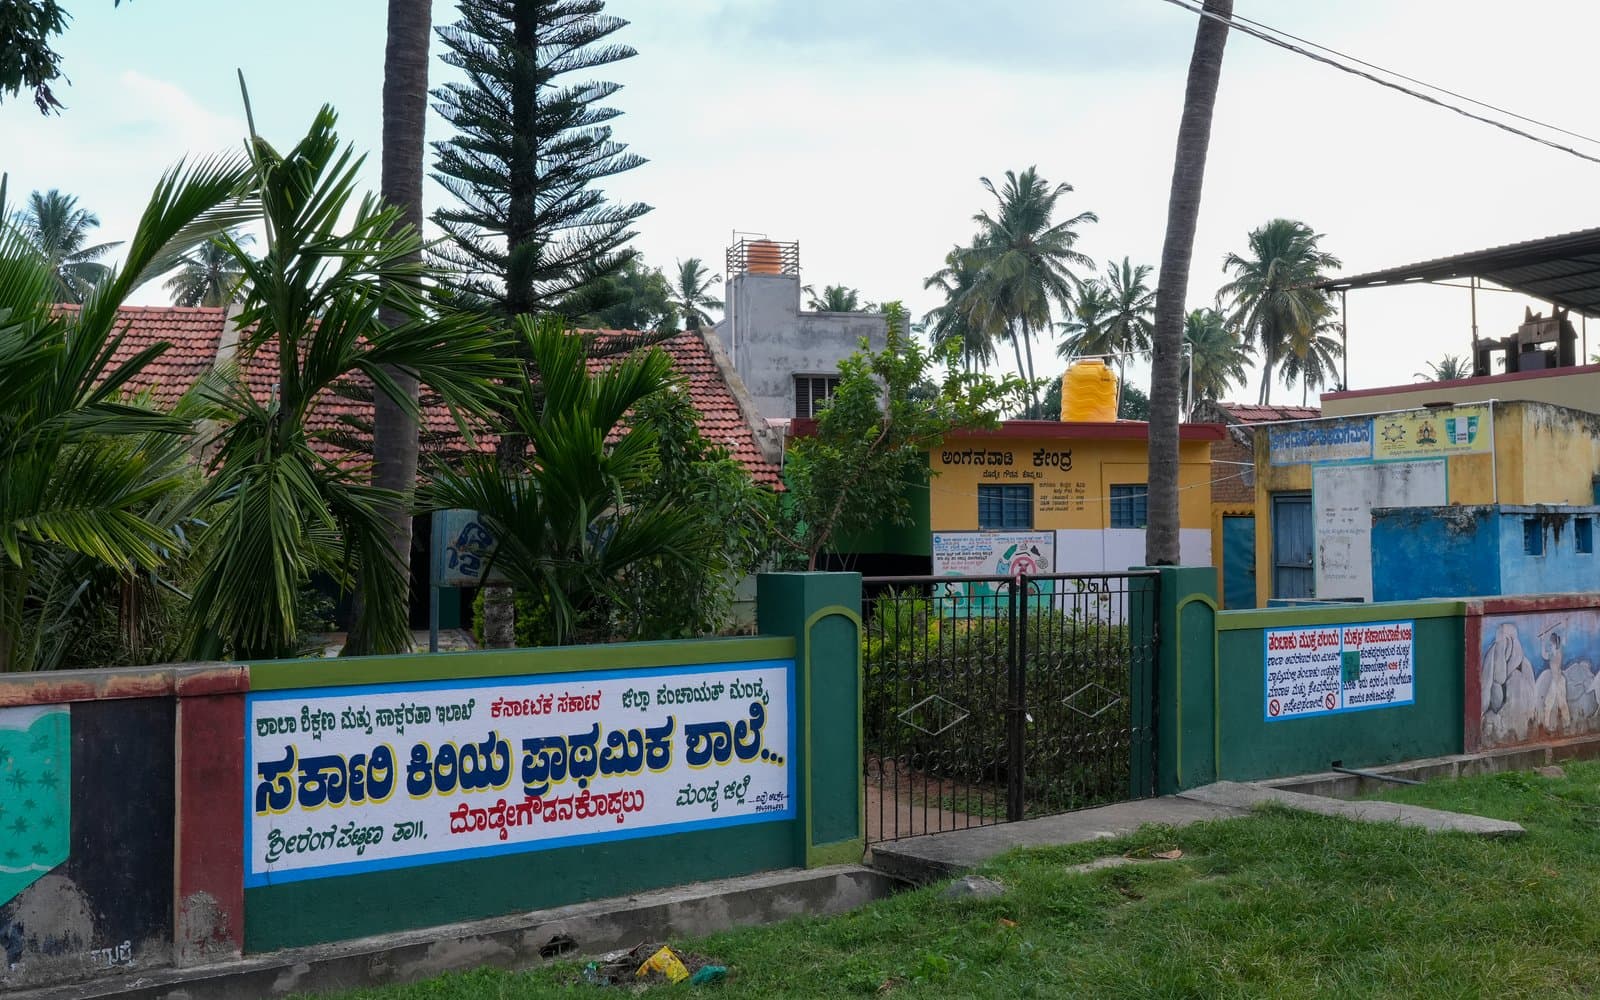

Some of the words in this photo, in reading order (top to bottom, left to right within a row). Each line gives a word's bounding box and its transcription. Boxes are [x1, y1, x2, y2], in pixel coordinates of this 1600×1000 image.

[941, 448, 1014, 466] ಅಂಗನವಾಡಿ
[1033, 447, 1073, 472] ಕೇಂದ್ರ
[1268, 632, 1297, 651] ತಂಬಾಕು
[1299, 630, 1318, 652] ಮುಕ್ತ
[1318, 629, 1340, 647] ವಲಯ
[1343, 628, 1364, 649] ಮಕ್ಕಳ
[490, 692, 554, 719] ಕರ್ನಾಟಕ
[557, 689, 602, 714] ಸರ್ಕಾರ
[622, 687, 651, 713] ಜಿಲ್ಲಾ
[656, 680, 725, 706] ಪಂಚಾಯತ್
[729, 677, 770, 706] ಮಂಡ್ಯ
[256, 713, 298, 737] ಶಾಲಾ
[300, 705, 336, 741] ಶಿಕ್ಷಣ
[340, 706, 374, 735] ಮತ್ತು
[375, 703, 432, 735] ಸಾಕ್ಷರತಾ
[435, 698, 476, 726] ಇಲಾಖೆ
[254, 743, 397, 816] ಸರ್ಕಾರಿ
[406, 730, 512, 798] ಕಿರಿಯ
[520, 715, 675, 796] ಪ್ರಾಥಮಿಕ
[675, 780, 720, 812] ಮಂಡ್ಯ
[723, 775, 752, 806] ಜಿಲ್ಲೆ
[449, 788, 645, 841] ದೊಡ್ಡೇಗೌಡನಕೊಪ್ಪಲು
